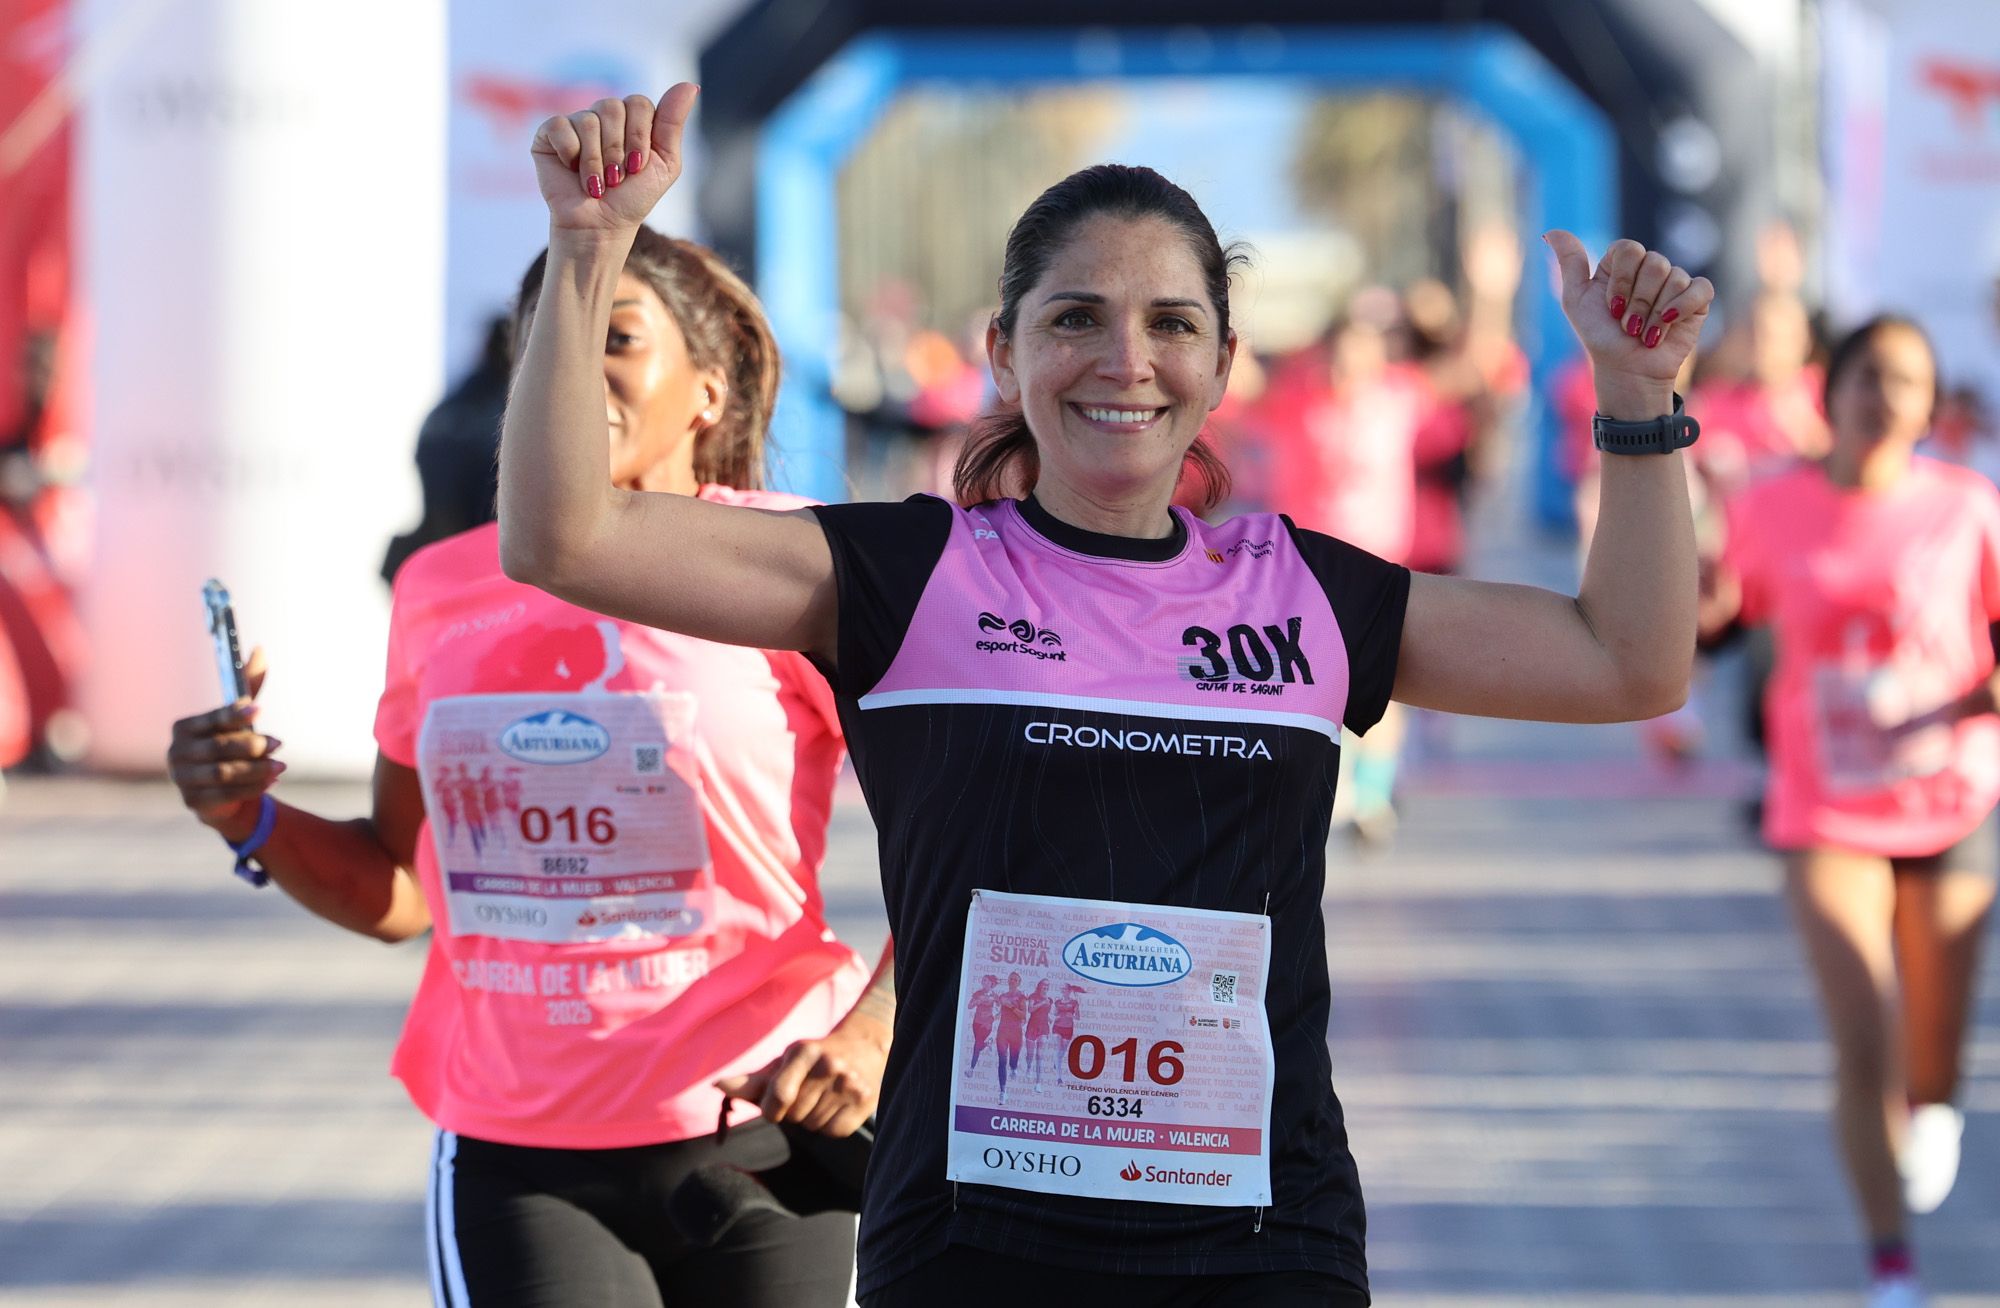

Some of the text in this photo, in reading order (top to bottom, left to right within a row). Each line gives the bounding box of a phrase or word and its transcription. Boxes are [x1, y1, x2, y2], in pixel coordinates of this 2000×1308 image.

[1182, 616, 1315, 685] 30K
[1196, 682, 1285, 696] CIUTAT DE SAGUNT
[1024, 721, 1273, 761] CRONOMETRA
[520, 805, 617, 845] 016
[475, 904, 548, 927] OYSHO
[600, 906, 683, 924] Santander
[989, 933, 1004, 945] TU
[1007, 935, 1050, 950] DORSAL
[1094, 942, 1136, 953] CENTRAL
[1139, 945, 1180, 956] LECHERA
[990, 945, 1049, 968] SUMA
[1071, 942, 1183, 974] ASTURIANA
[540, 963, 573, 997] DE
[577, 963, 612, 994] LA
[615, 948, 711, 992] MUJER
[546, 1000, 593, 1026] 2025
[1068, 1034, 1185, 1086] 016
[1087, 1095, 1143, 1119] 6334
[991, 1115, 1230, 1149] CARRERA DE LA MUJER VALENCIA
[983, 1147, 1082, 1177] OYSHO
[1145, 1165, 1233, 1187] Santander
